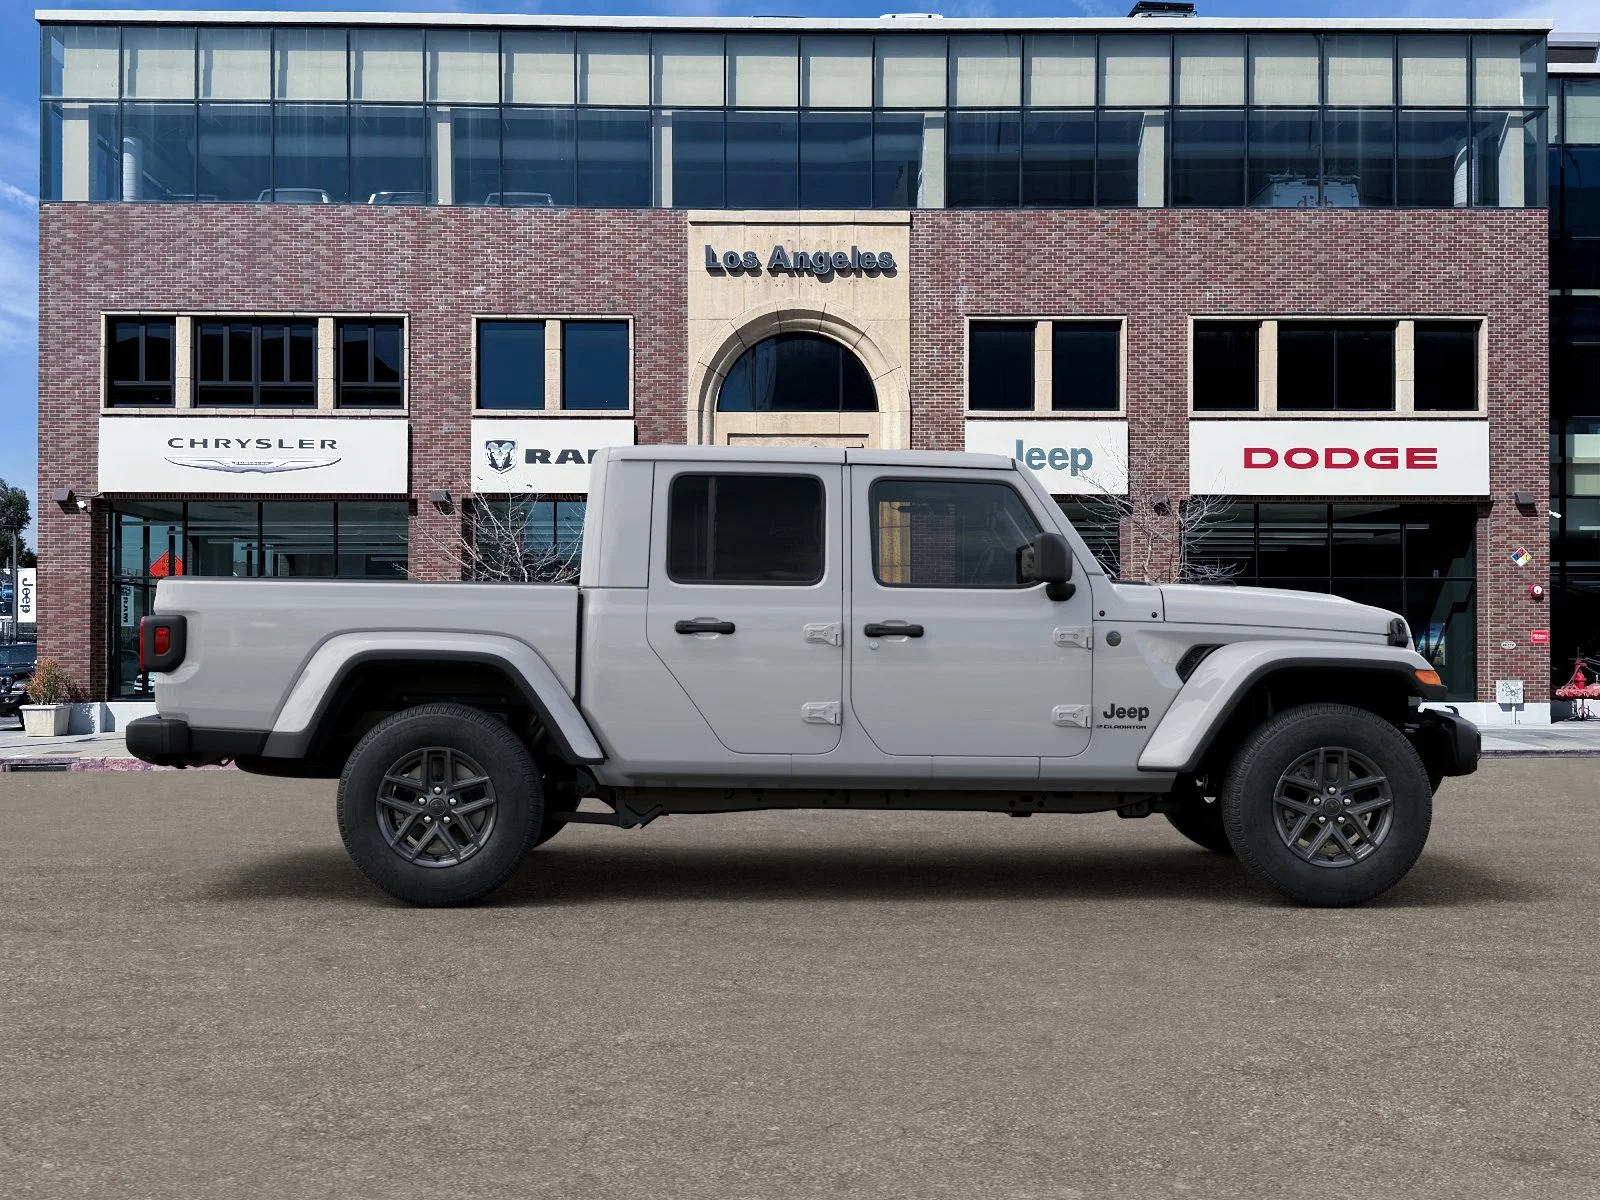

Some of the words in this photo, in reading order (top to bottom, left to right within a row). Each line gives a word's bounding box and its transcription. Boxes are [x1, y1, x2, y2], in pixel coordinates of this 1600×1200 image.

[705, 245, 758, 269] Los
[767, 245, 895, 275] Angeles
[167, 437, 338, 450] CHRYSLER
[525, 448, 600, 465] RA
[1243, 447, 1438, 470] DODGE
[20, 577, 33, 613] Jeep
[1103, 703, 1150, 722] Jeep
